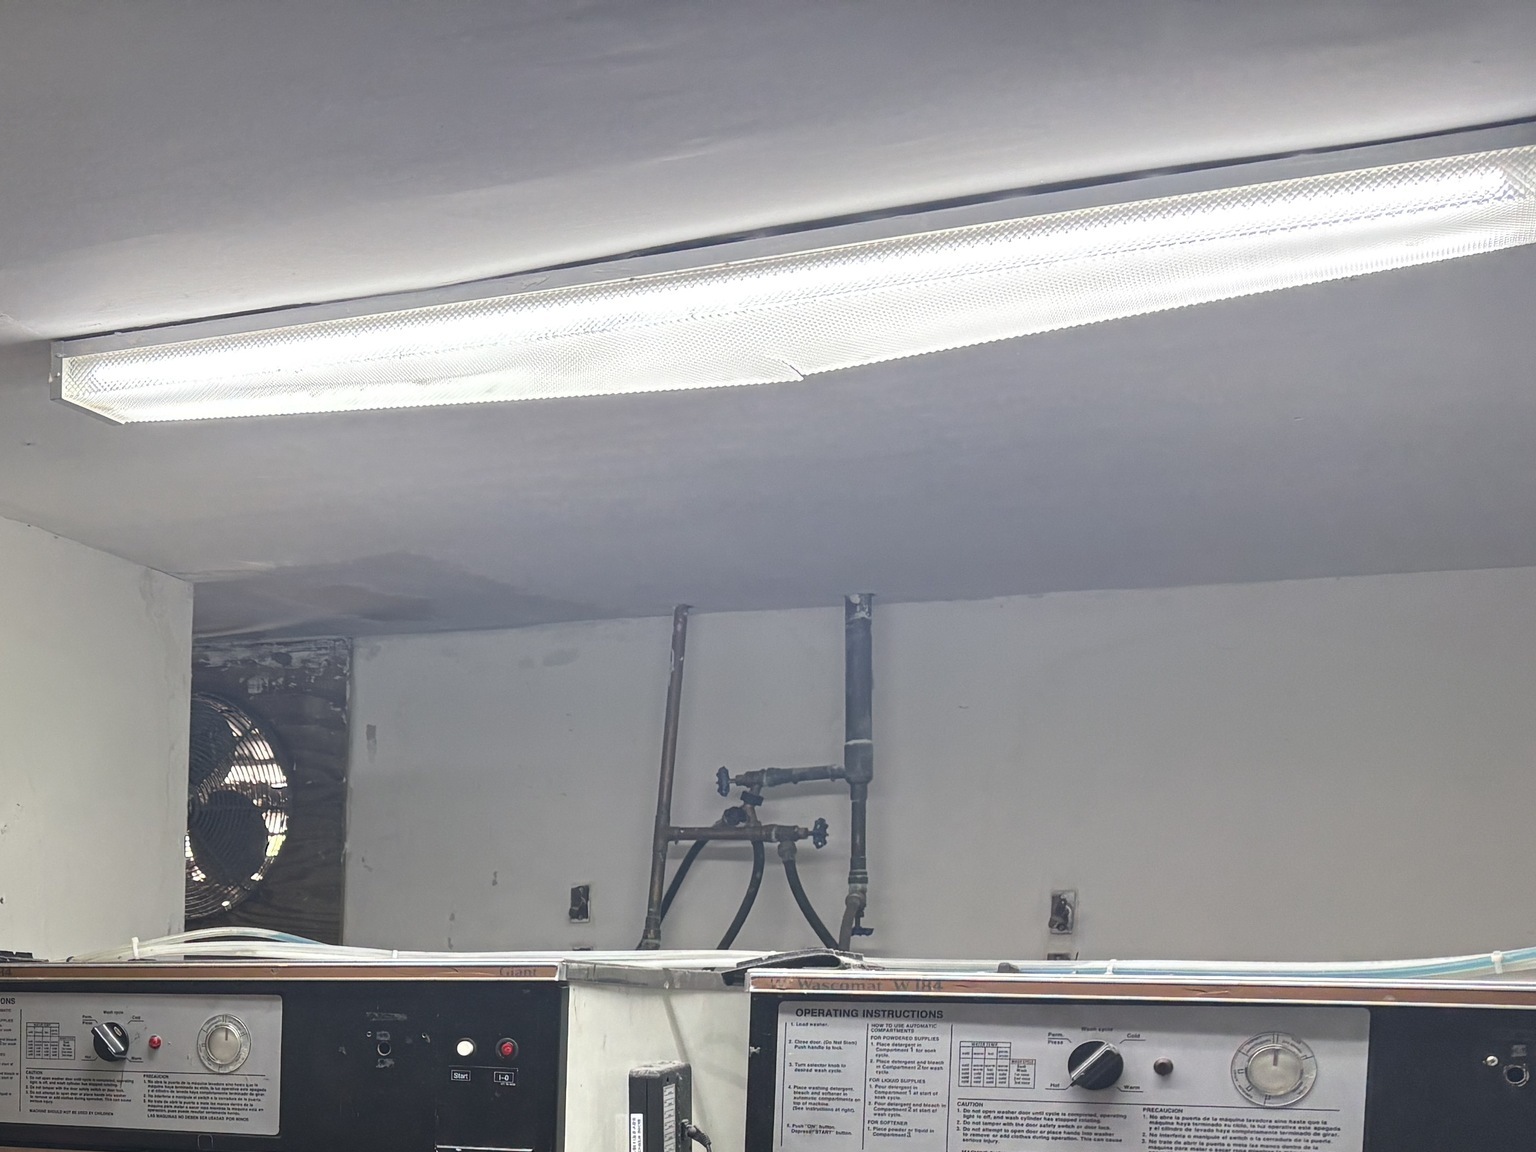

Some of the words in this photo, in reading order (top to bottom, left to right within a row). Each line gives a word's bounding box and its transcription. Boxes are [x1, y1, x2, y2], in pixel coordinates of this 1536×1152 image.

[798, 978, 883, 990] Wascomat
[796, 1008, 859, 1018] OPERATING
[862, 1009, 944, 1018] INSTRUCTIONS
